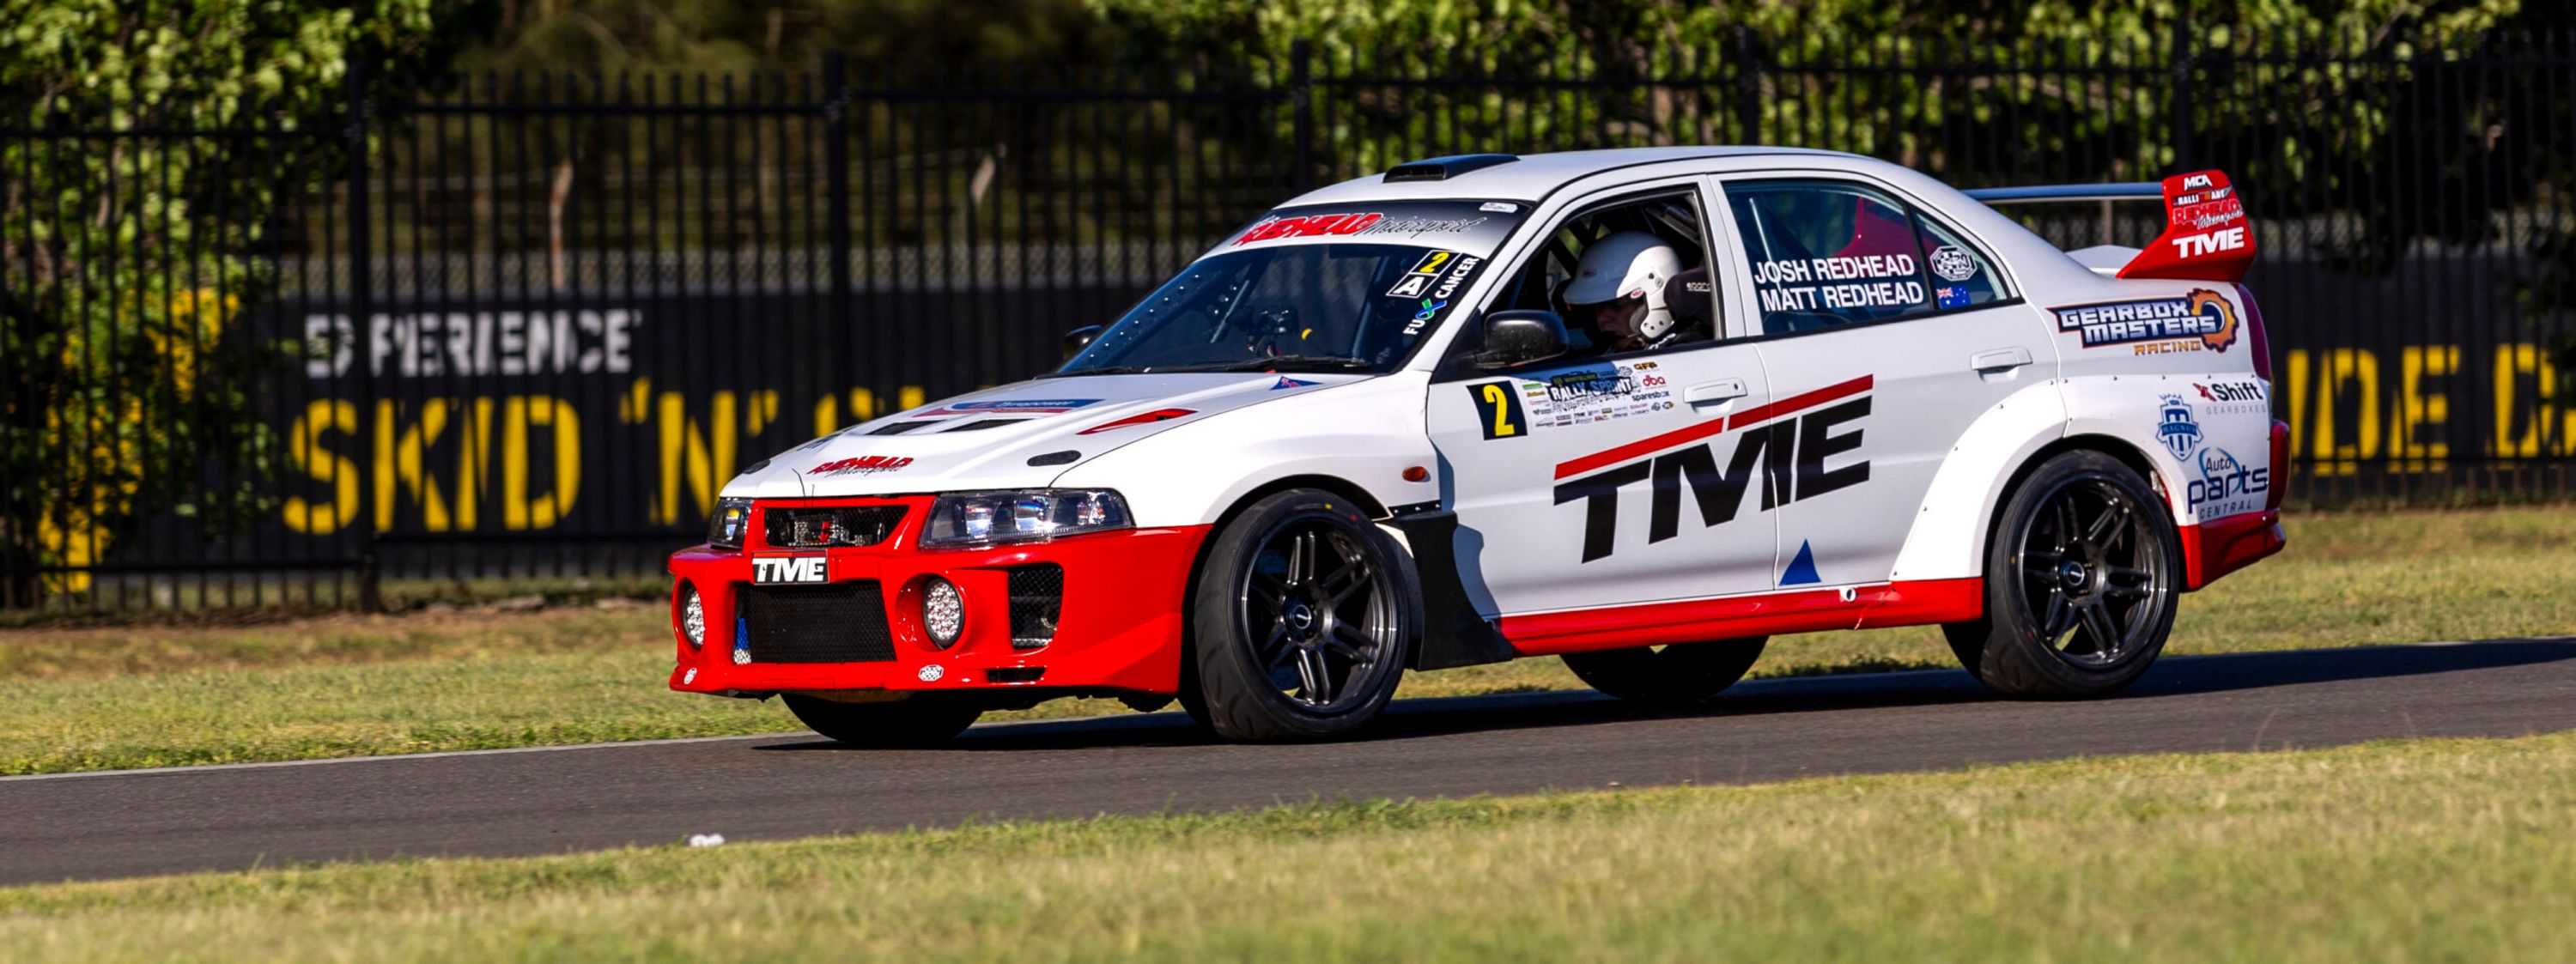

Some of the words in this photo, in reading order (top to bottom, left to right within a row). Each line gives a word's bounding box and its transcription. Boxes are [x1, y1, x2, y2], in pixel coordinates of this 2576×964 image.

[2184, 173, 2213, 191] MCA
[2172, 198, 2242, 225] REDHEAD
[1352, 215, 1487, 239] Motorsport
[2172, 227, 2245, 258] TME
[1419, 252, 1449, 273] 2
[1754, 259, 1813, 284] JOSH
[1815, 254, 1915, 281] REDHEAD
[1392, 276, 1425, 296] A
[1435, 257, 1480, 299] CANCER
[1760, 288, 1817, 312] MATT
[1823, 281, 1924, 308] REDHEAD
[2060, 300, 2190, 328] GEARBOX
[2082, 315, 2218, 343] MASTERS
[2134, 340, 2202, 356] RACING
[1550, 381, 1587, 401] RALLY
[1590, 378, 1631, 397] SPRINT
[1643, 374, 1666, 386] dba
[1483, 384, 1515, 437] 2
[2206, 404, 2266, 415] GEARBOXES
[283, 395, 582, 535] SKID
[2206, 456, 2232, 473] Auto
[1553, 394, 1874, 564] TME
[2188, 465, 2268, 514] parts
[2199, 499, 2252, 520] CENTRAL
[752, 557, 827, 583] TME
